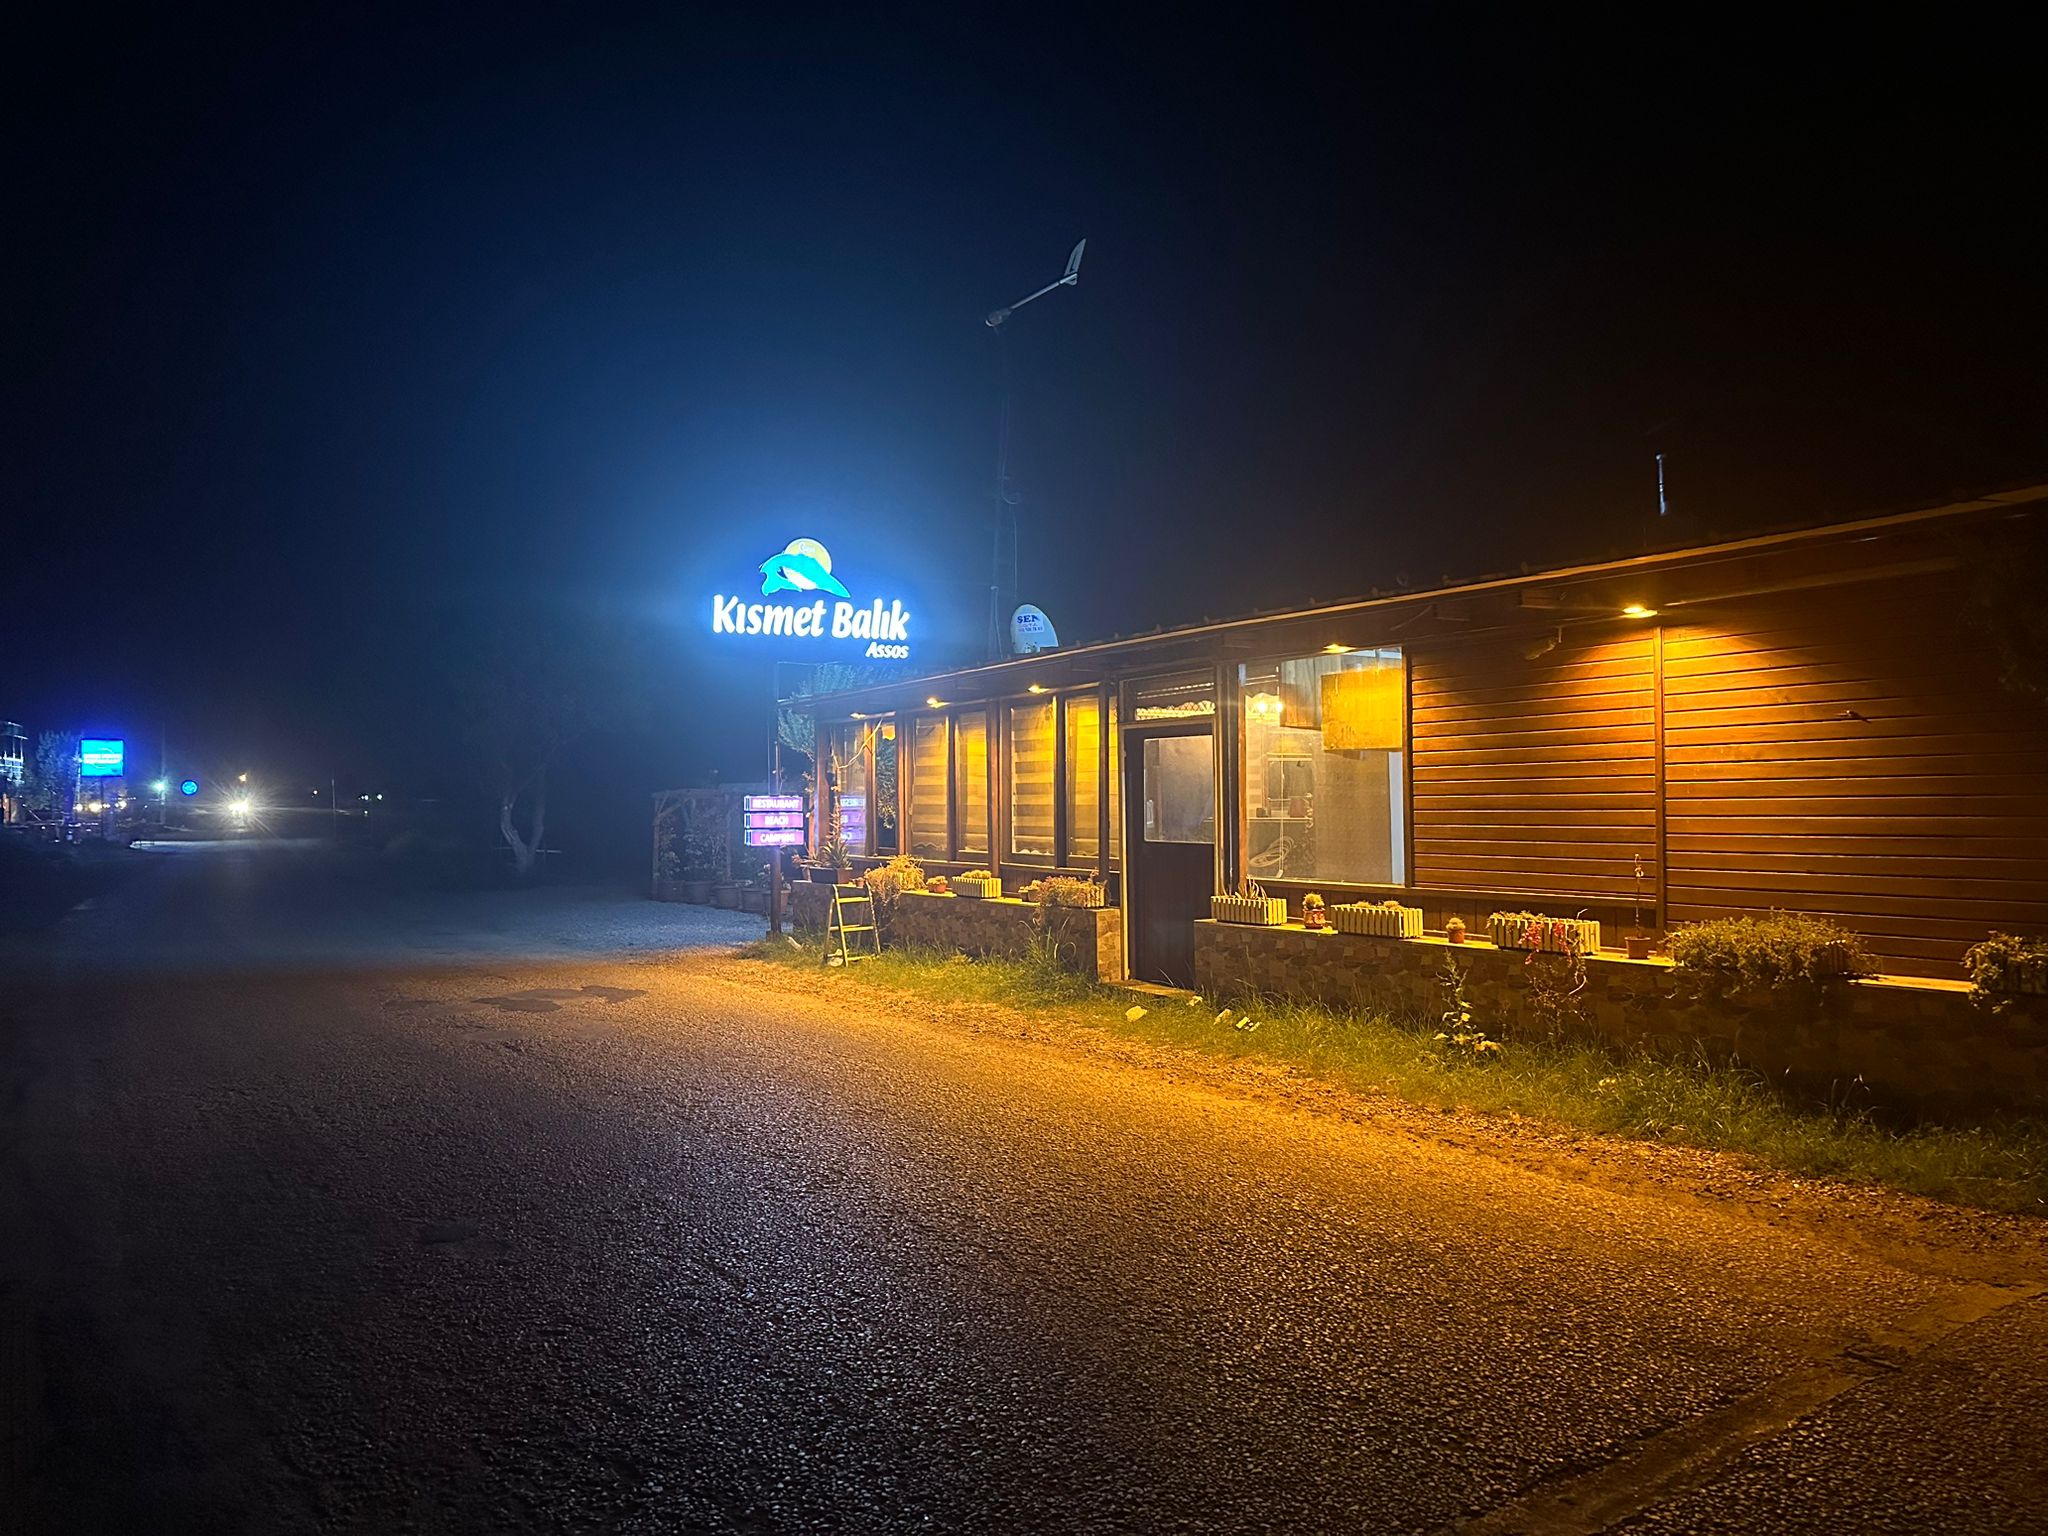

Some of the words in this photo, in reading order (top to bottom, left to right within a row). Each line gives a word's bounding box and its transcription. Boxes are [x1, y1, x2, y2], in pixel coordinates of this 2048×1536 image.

[712, 594, 826, 637] Kısmet
[831, 598, 910, 641] Balık
[865, 642, 910, 659] Assos
[752, 799, 800, 809] RESTAURANT
[764, 815, 789, 826] BEACH
[760, 833, 796, 843] CAMPING
